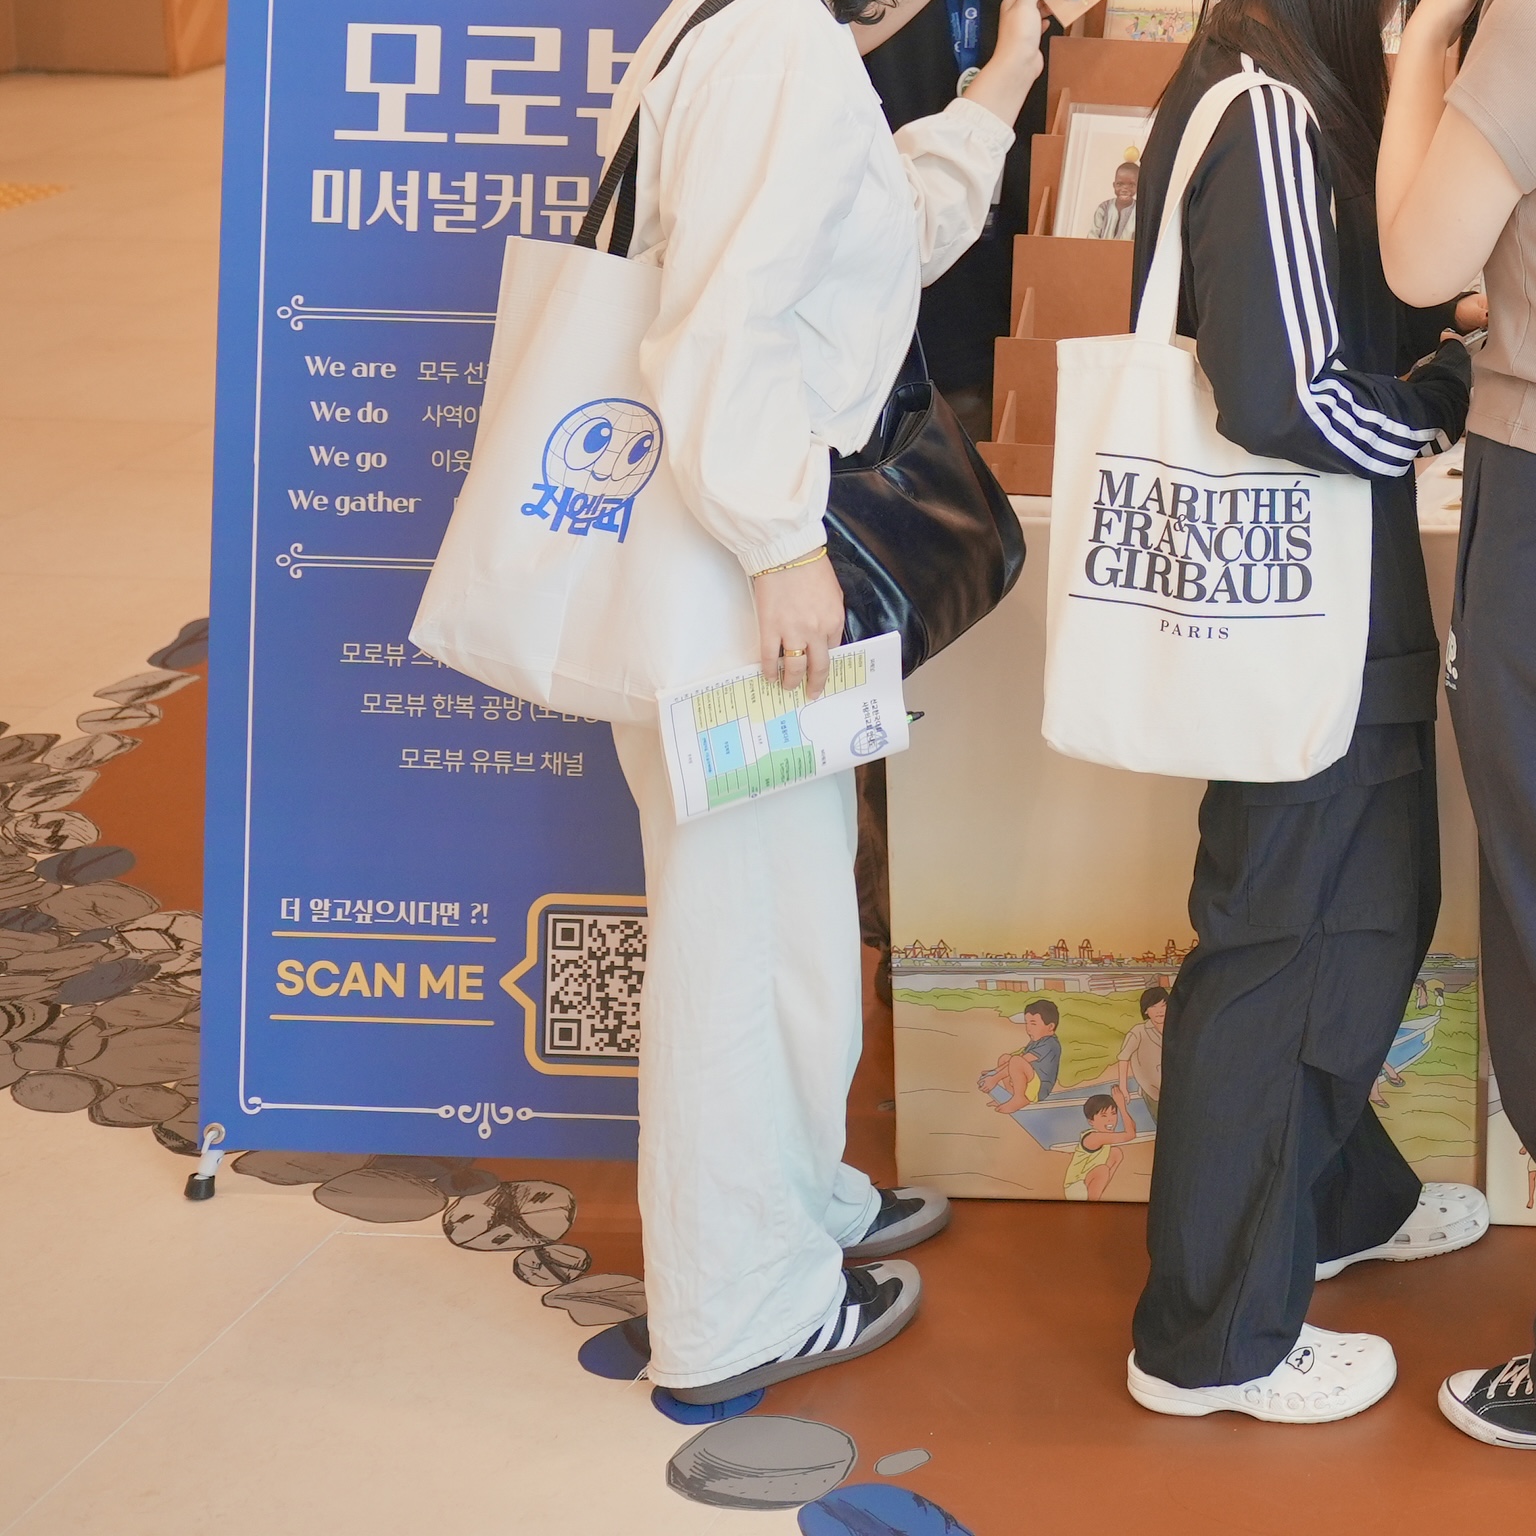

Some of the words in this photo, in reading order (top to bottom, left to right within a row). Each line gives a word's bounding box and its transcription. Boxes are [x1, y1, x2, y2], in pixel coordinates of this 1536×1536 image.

[304, 355, 346, 378] We
[351, 361, 397, 379] are
[417, 361, 459, 384] 모두
[463, 361, 489, 385] 선
[309, 400, 351, 423] We
[356, 401, 389, 424] do
[308, 445, 349, 467] We
[355, 451, 387, 472] go
[287, 489, 328, 511] We
[334, 490, 422, 516] gather
[1094, 468, 1312, 526] MARITHÉ
[1173, 514, 1187, 533] &
[1088, 506, 1313, 571] FRANÇOIS
[1085, 545, 1313, 605] GIRBAUD
[1159, 619, 1230, 640] PARIS
[339, 642, 407, 668] 모로뷰
[360, 693, 427, 718] 모로뷰
[431, 693, 476, 720] 한복
[480, 695, 525, 722] 공방
[398, 748, 466, 774] 모로뷰
[469, 749, 536, 775] 유튜브
[540, 751, 584, 777] 채널
[279, 896, 301, 924] 더
[308, 896, 461, 928] 알고싶으시다면
[275, 958, 406, 999] SCAN
[419, 963, 485, 1002] ME
